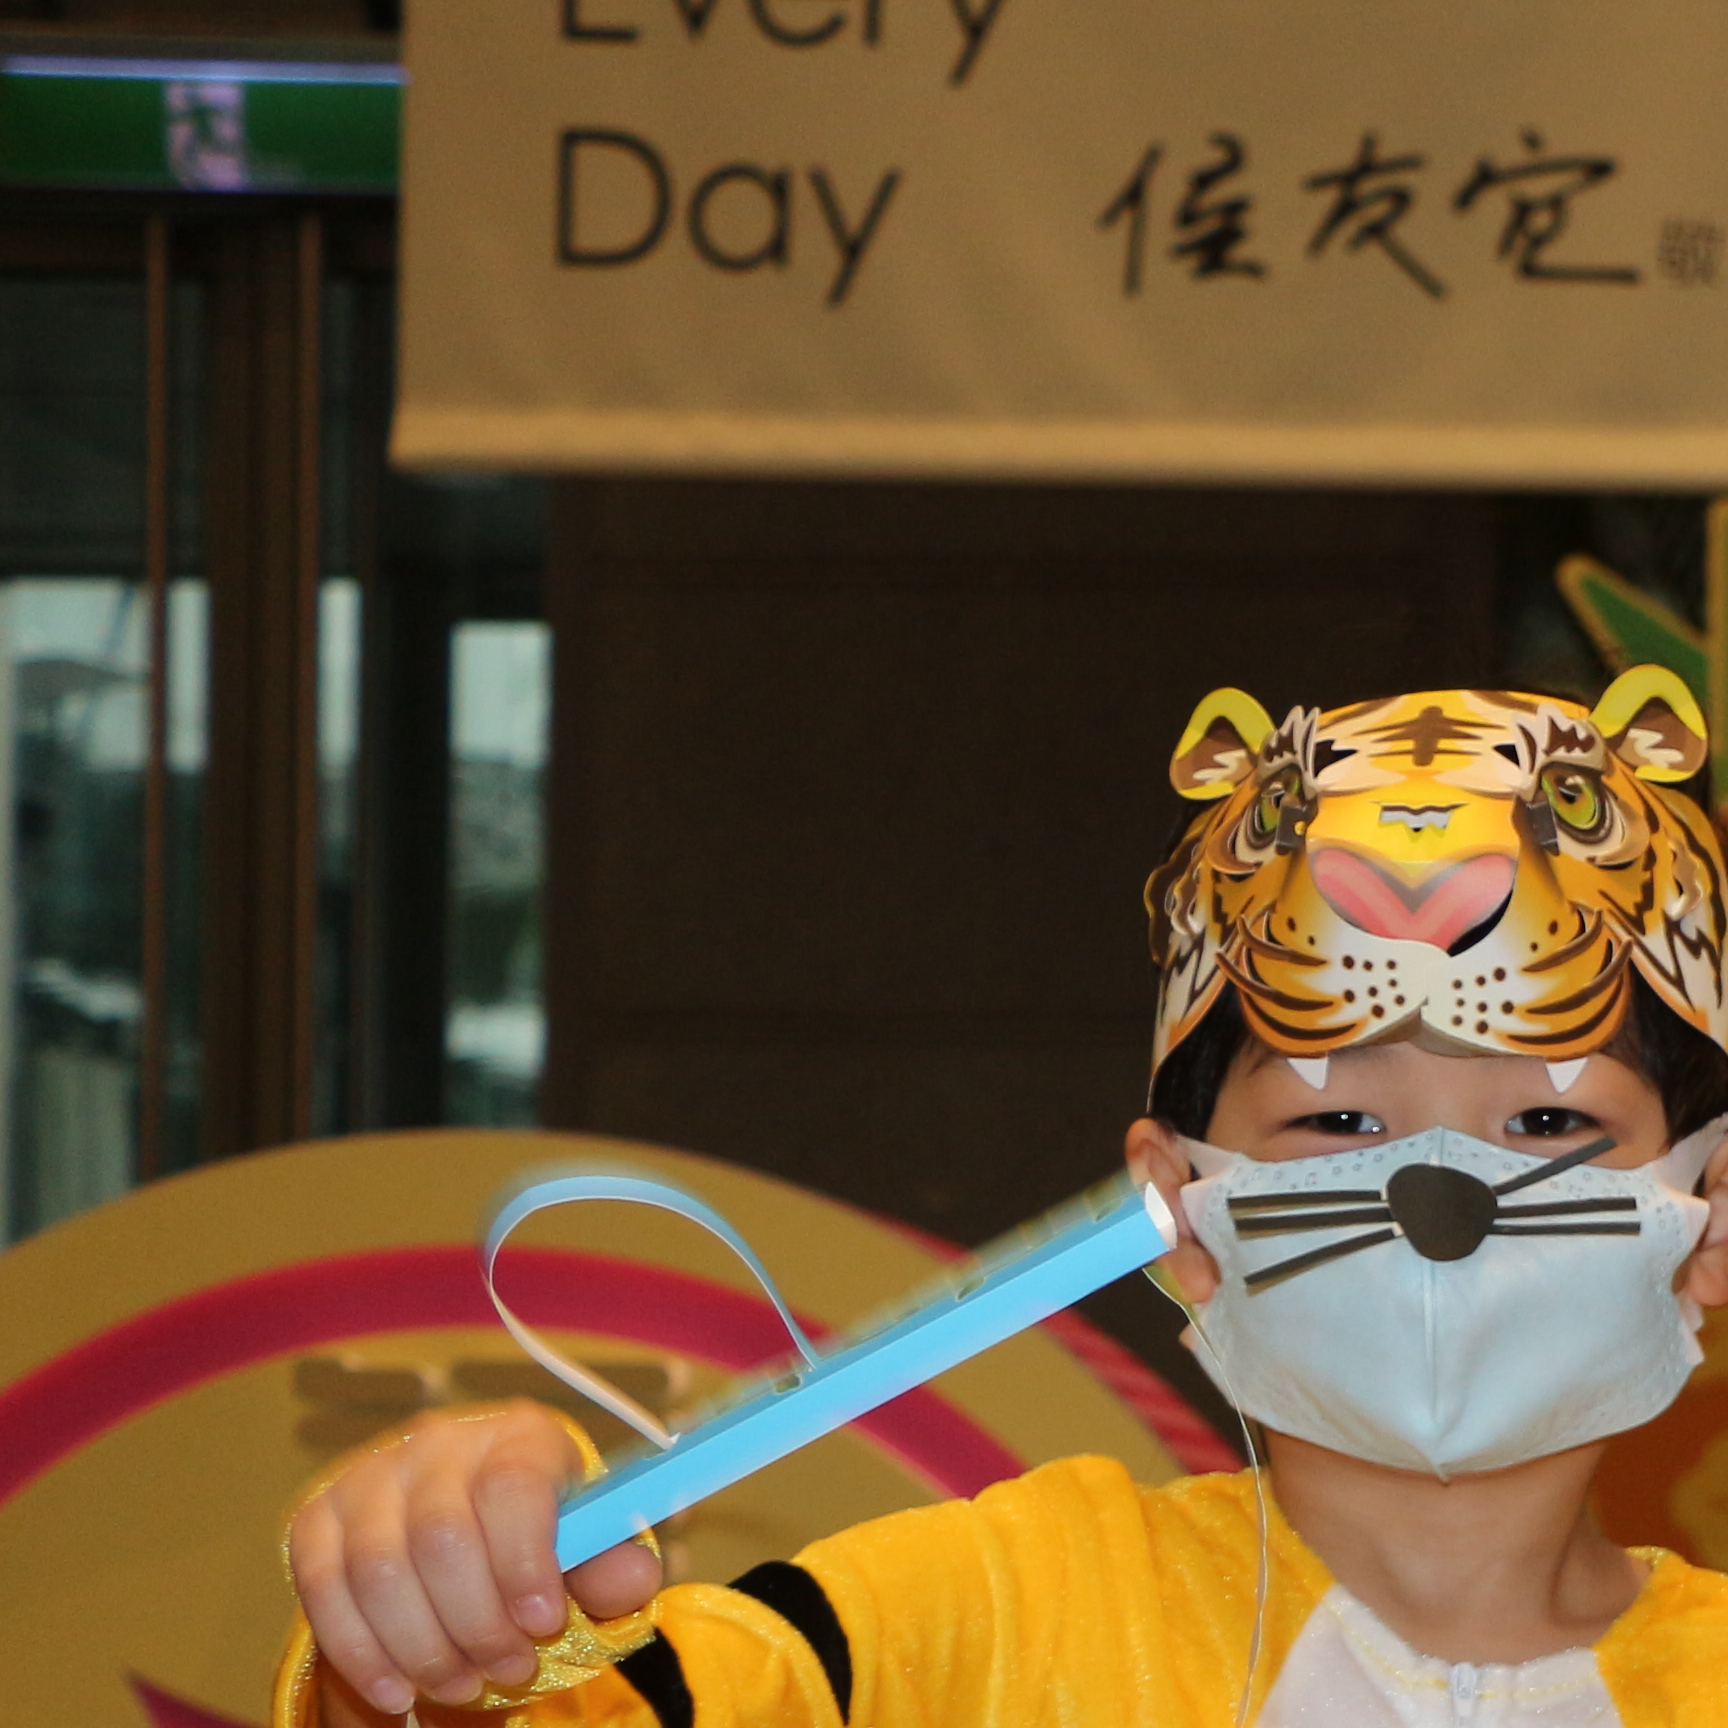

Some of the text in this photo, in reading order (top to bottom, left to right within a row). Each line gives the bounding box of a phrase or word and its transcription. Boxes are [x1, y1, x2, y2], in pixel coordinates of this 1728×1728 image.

[557, 127, 903, 307] Day
[1096, 130, 1640, 298] 侯友宜
